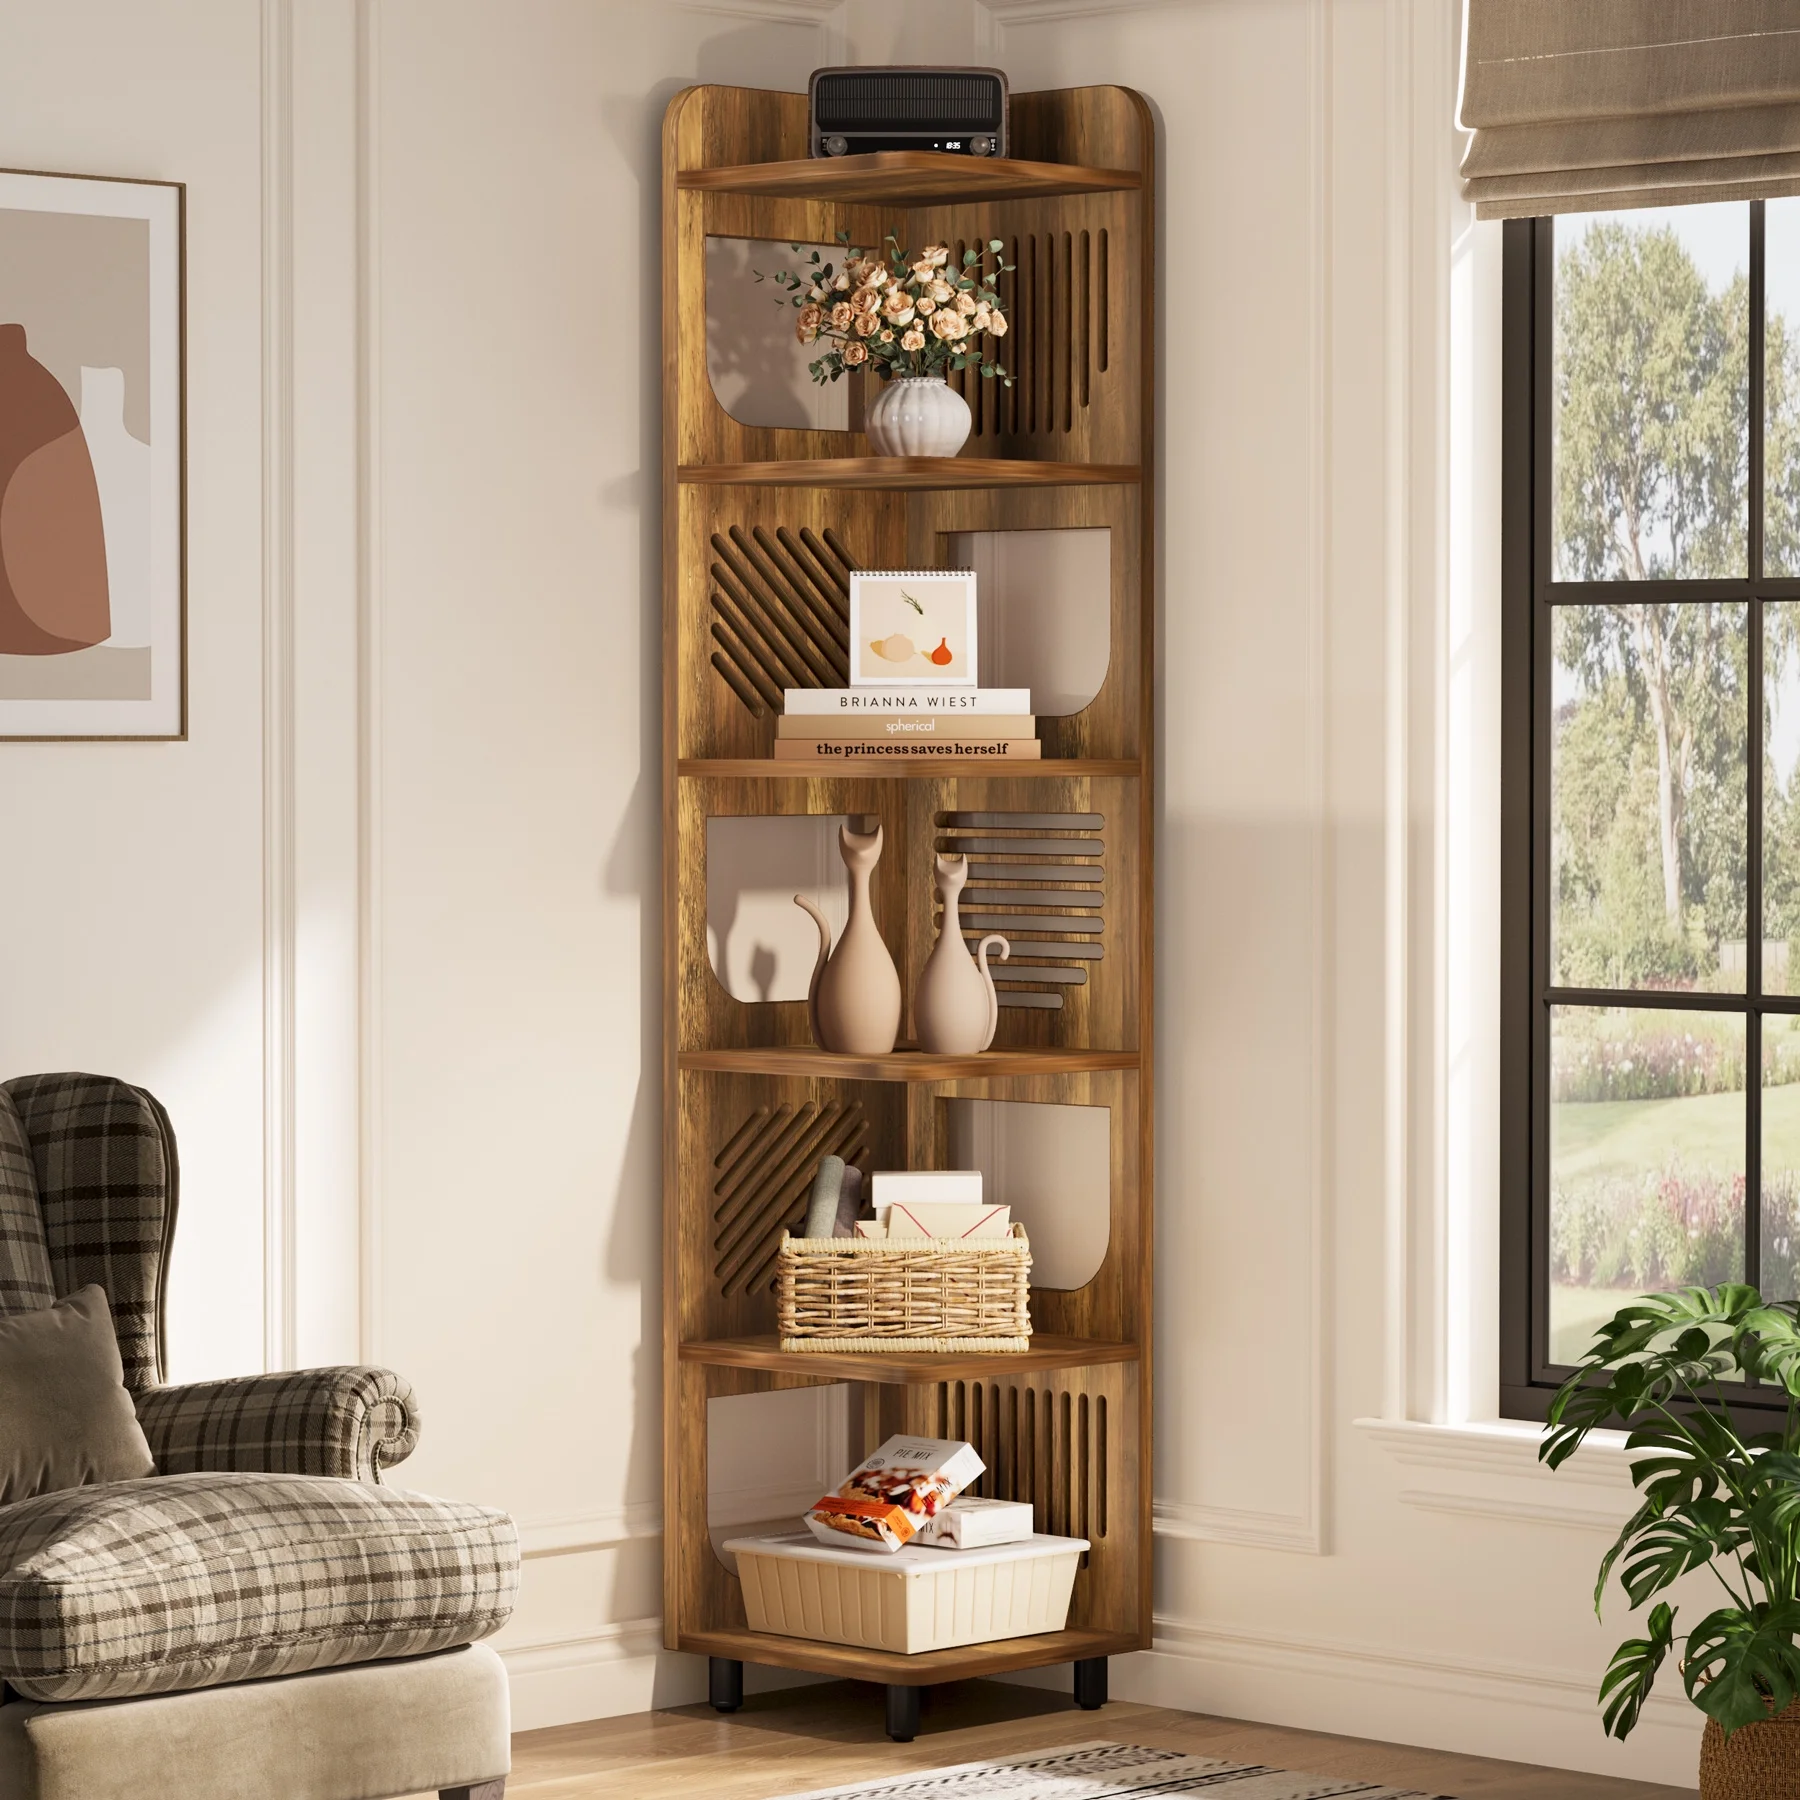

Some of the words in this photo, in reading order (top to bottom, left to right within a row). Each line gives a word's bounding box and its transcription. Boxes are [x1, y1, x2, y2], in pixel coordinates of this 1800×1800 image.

[840, 696, 918, 707] BRIANNA
[927, 696, 977, 707] WIEST
[886, 718, 935, 734] spherical
[816, 743, 842, 754] the
[844, 743, 909, 757] princess
[911, 745, 953, 754] saves
[955, 743, 1009, 754] herself
[893, 1448, 913, 1459] PIE
[912, 1451, 934, 1461] MIX
